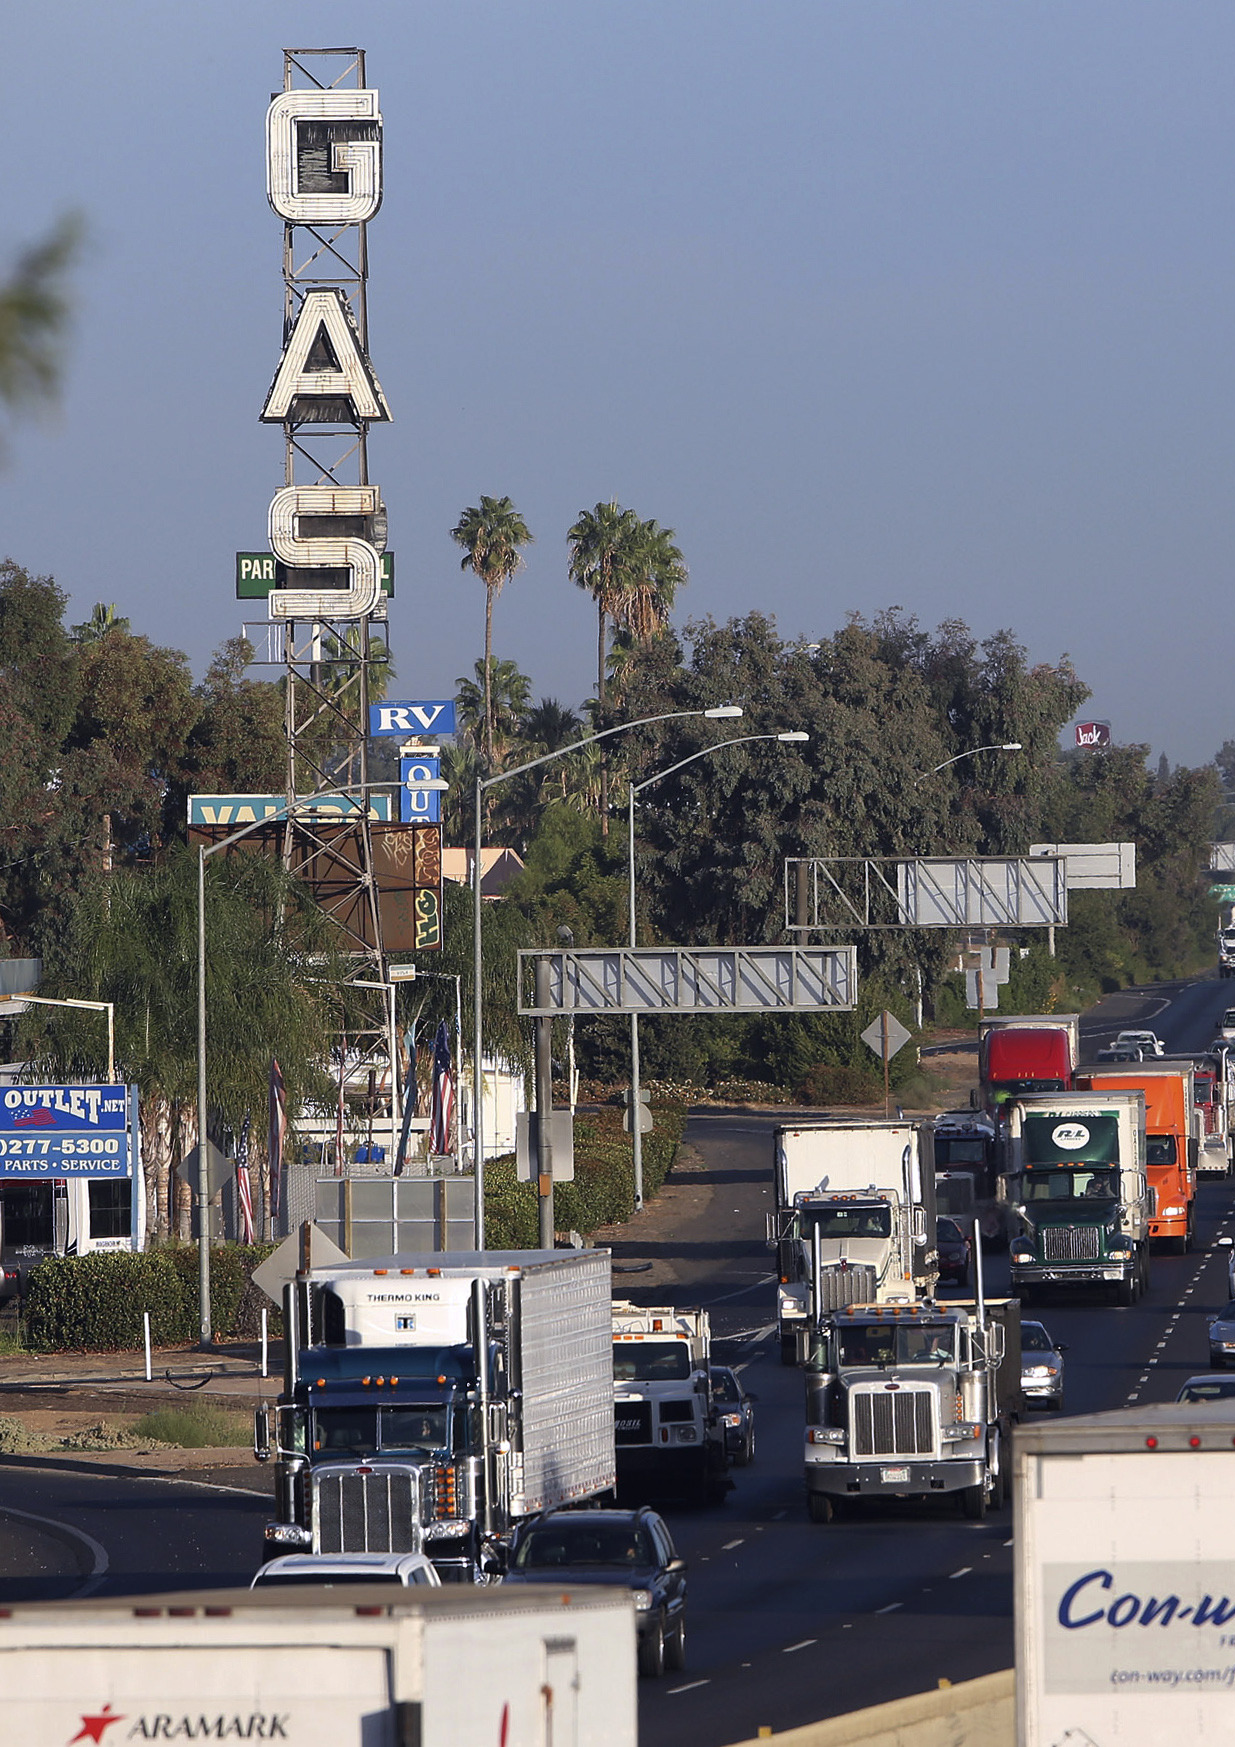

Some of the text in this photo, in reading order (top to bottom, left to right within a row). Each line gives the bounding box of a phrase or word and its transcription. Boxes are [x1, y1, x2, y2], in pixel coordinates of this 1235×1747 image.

[258, 88, 393, 620] GAS
[241, 559, 276, 580] PAR
[379, 705, 445, 731] RV
[1077, 725, 1101, 746] Jack
[4, 1159, 121, 1171] PARTS SERVICE
[367, 1293, 440, 1302] THERMO KING
[127, 1712, 290, 1740] ARAMARK
